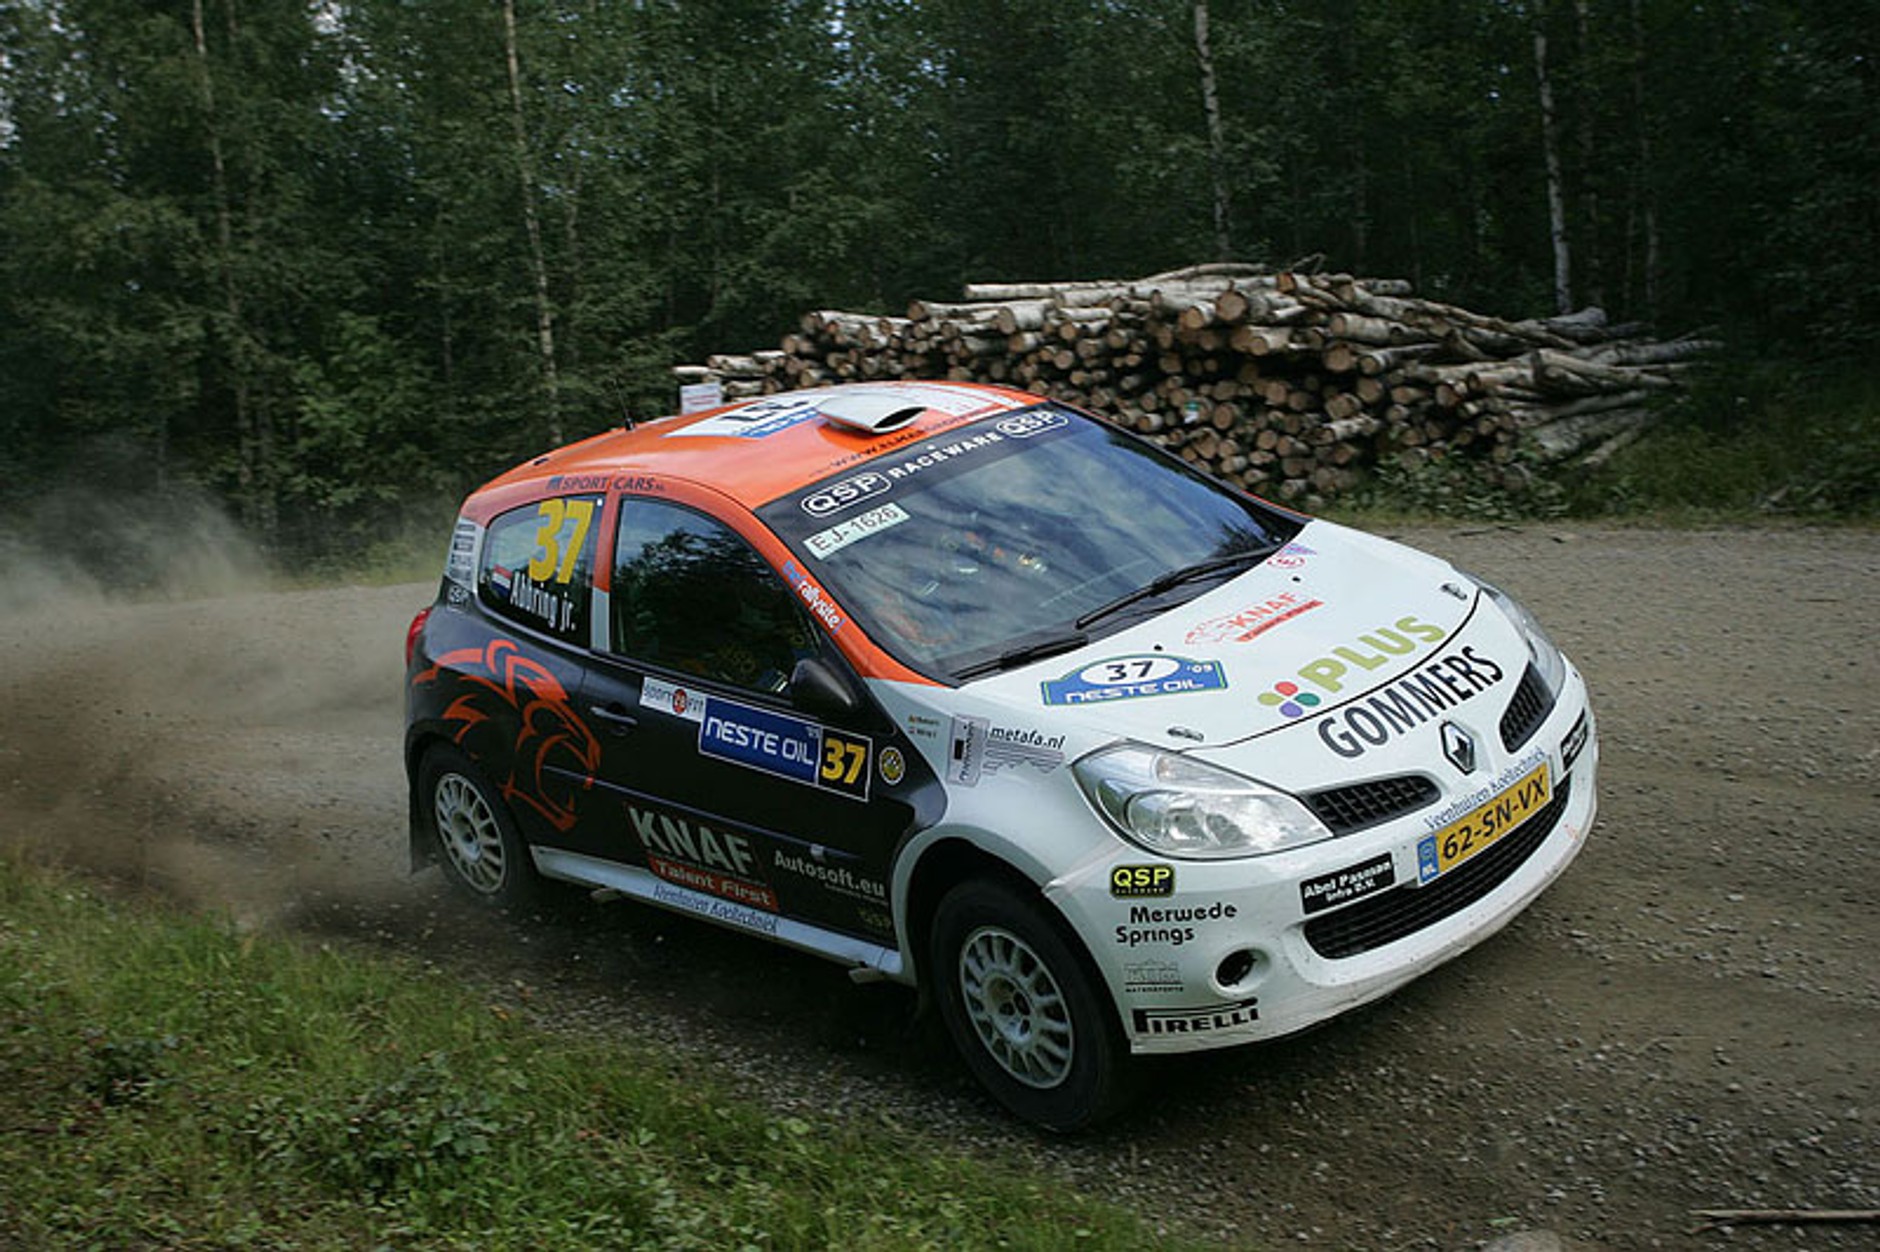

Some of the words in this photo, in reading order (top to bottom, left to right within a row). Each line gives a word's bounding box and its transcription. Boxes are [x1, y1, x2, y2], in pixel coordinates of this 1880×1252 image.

[563, 476, 608, 491] SPORT
[808, 474, 880, 512] QSP
[887, 431, 1003, 479] RACEWARE
[1001, 410, 1060, 435] QSP
[529, 498, 594, 585] 37
[559, 591, 577, 633] jr.
[1105, 660, 1155, 682] 37
[1298, 616, 1447, 694] PLUS
[1064, 682, 1160, 705] NESTE
[1162, 678, 1206, 693] OIL
[1318, 645, 1504, 759] GOMMERS
[704, 715, 780, 757] NESTE
[781, 738, 816, 766] OIL
[820, 736, 867, 786] 37
[990, 727, 1067, 750] metafa.nl
[1441, 773, 1547, 861] 62-SN-VX
[628, 806, 754, 876] KNAF
[656, 860, 717, 890] Talent
[720, 879, 771, 907] First
[775, 849, 886, 899] Autosoft.eu
[1113, 868, 1171, 888] QSP
[1115, 925, 1195, 948] Springs
[1130, 902, 1238, 924] Merwede
[1132, 997, 1260, 1034] PIRELLI
